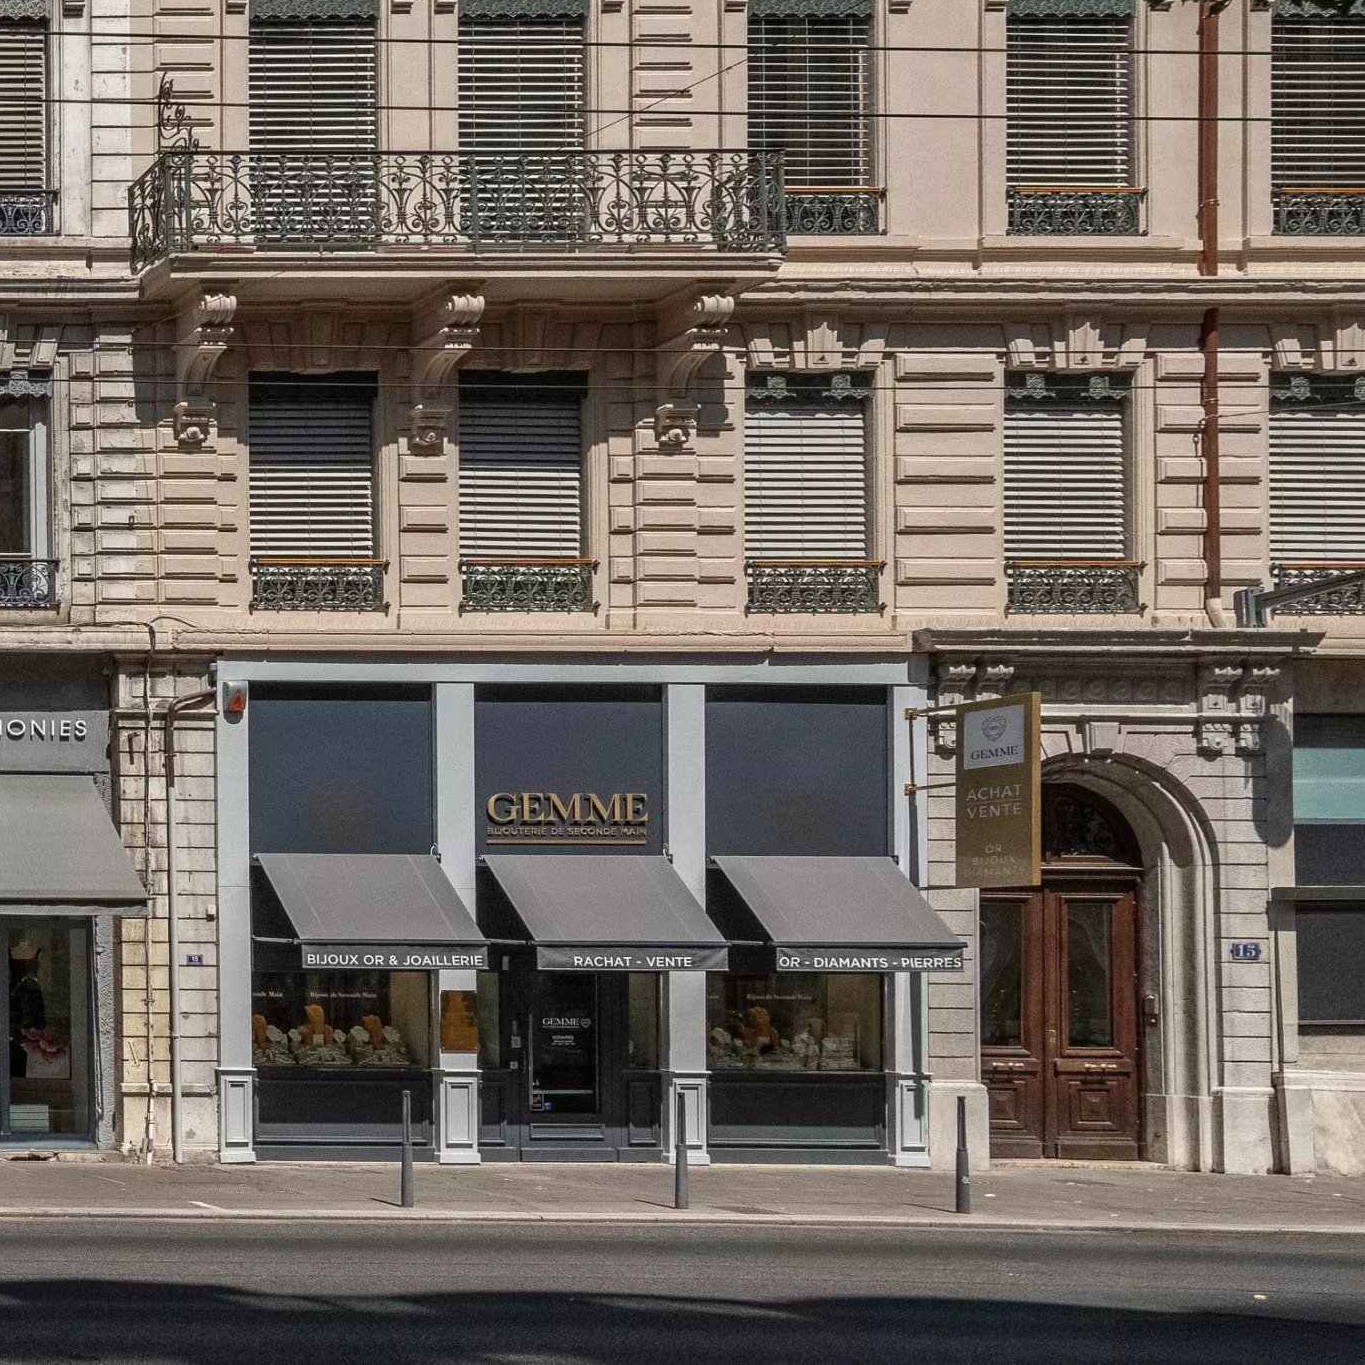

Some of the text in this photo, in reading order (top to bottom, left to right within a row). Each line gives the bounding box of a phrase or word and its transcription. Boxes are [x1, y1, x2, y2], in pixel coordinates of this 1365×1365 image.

[971, 745, 1019, 761] GEMME
[967, 784, 1022, 801] ACHAT
[487, 792, 649, 822] GEMME
[967, 803, 1022, 819] VENTE
[487, 827, 647, 835] BIJOUTERIE DE SECONDE MAIN
[985, 844, 1002, 853] OR
[1237, 944, 1256, 957] 15
[307, 954, 483, 966] BIJOUX OR & JOAILLERIE
[573, 956, 632, 967] RACHAT
[646, 956, 693, 967] VENTE
[779, 957, 801, 967] OR
[814, 957, 889, 968] DIAMANTS
[901, 957, 962, 968] PIERRES
